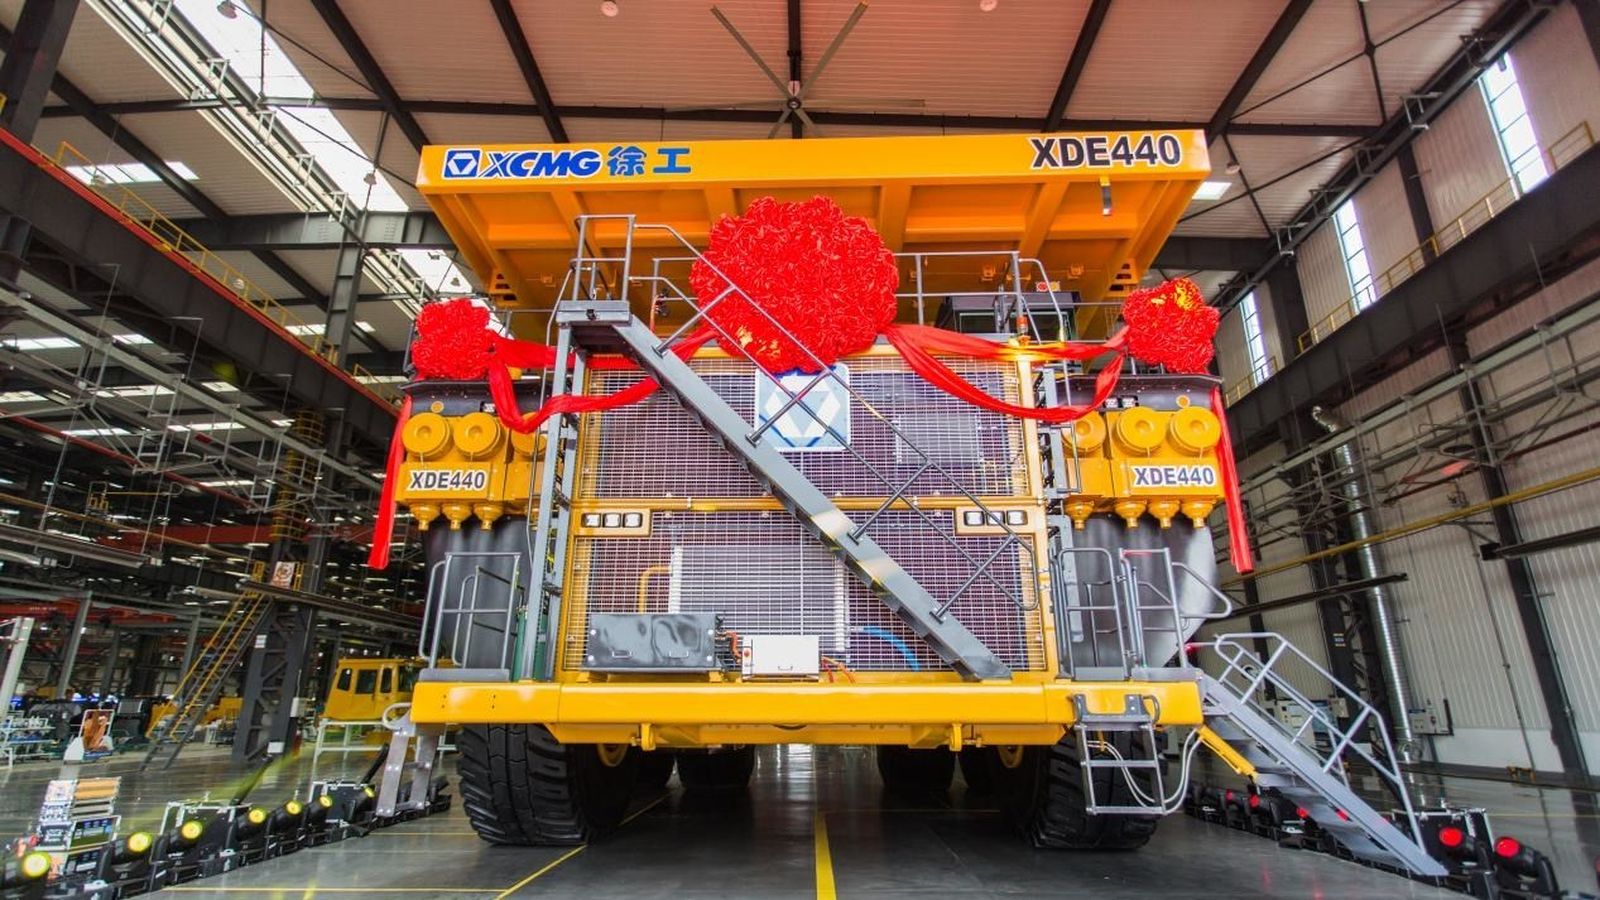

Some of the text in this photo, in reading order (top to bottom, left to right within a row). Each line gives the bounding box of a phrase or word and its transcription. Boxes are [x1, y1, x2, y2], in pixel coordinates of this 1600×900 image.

[478, 146, 692, 177] XCMG 徐工
[1031, 135, 1181, 168] XDE440
[409, 471, 486, 489] XDE440
[1134, 466, 1214, 486] XDE440
